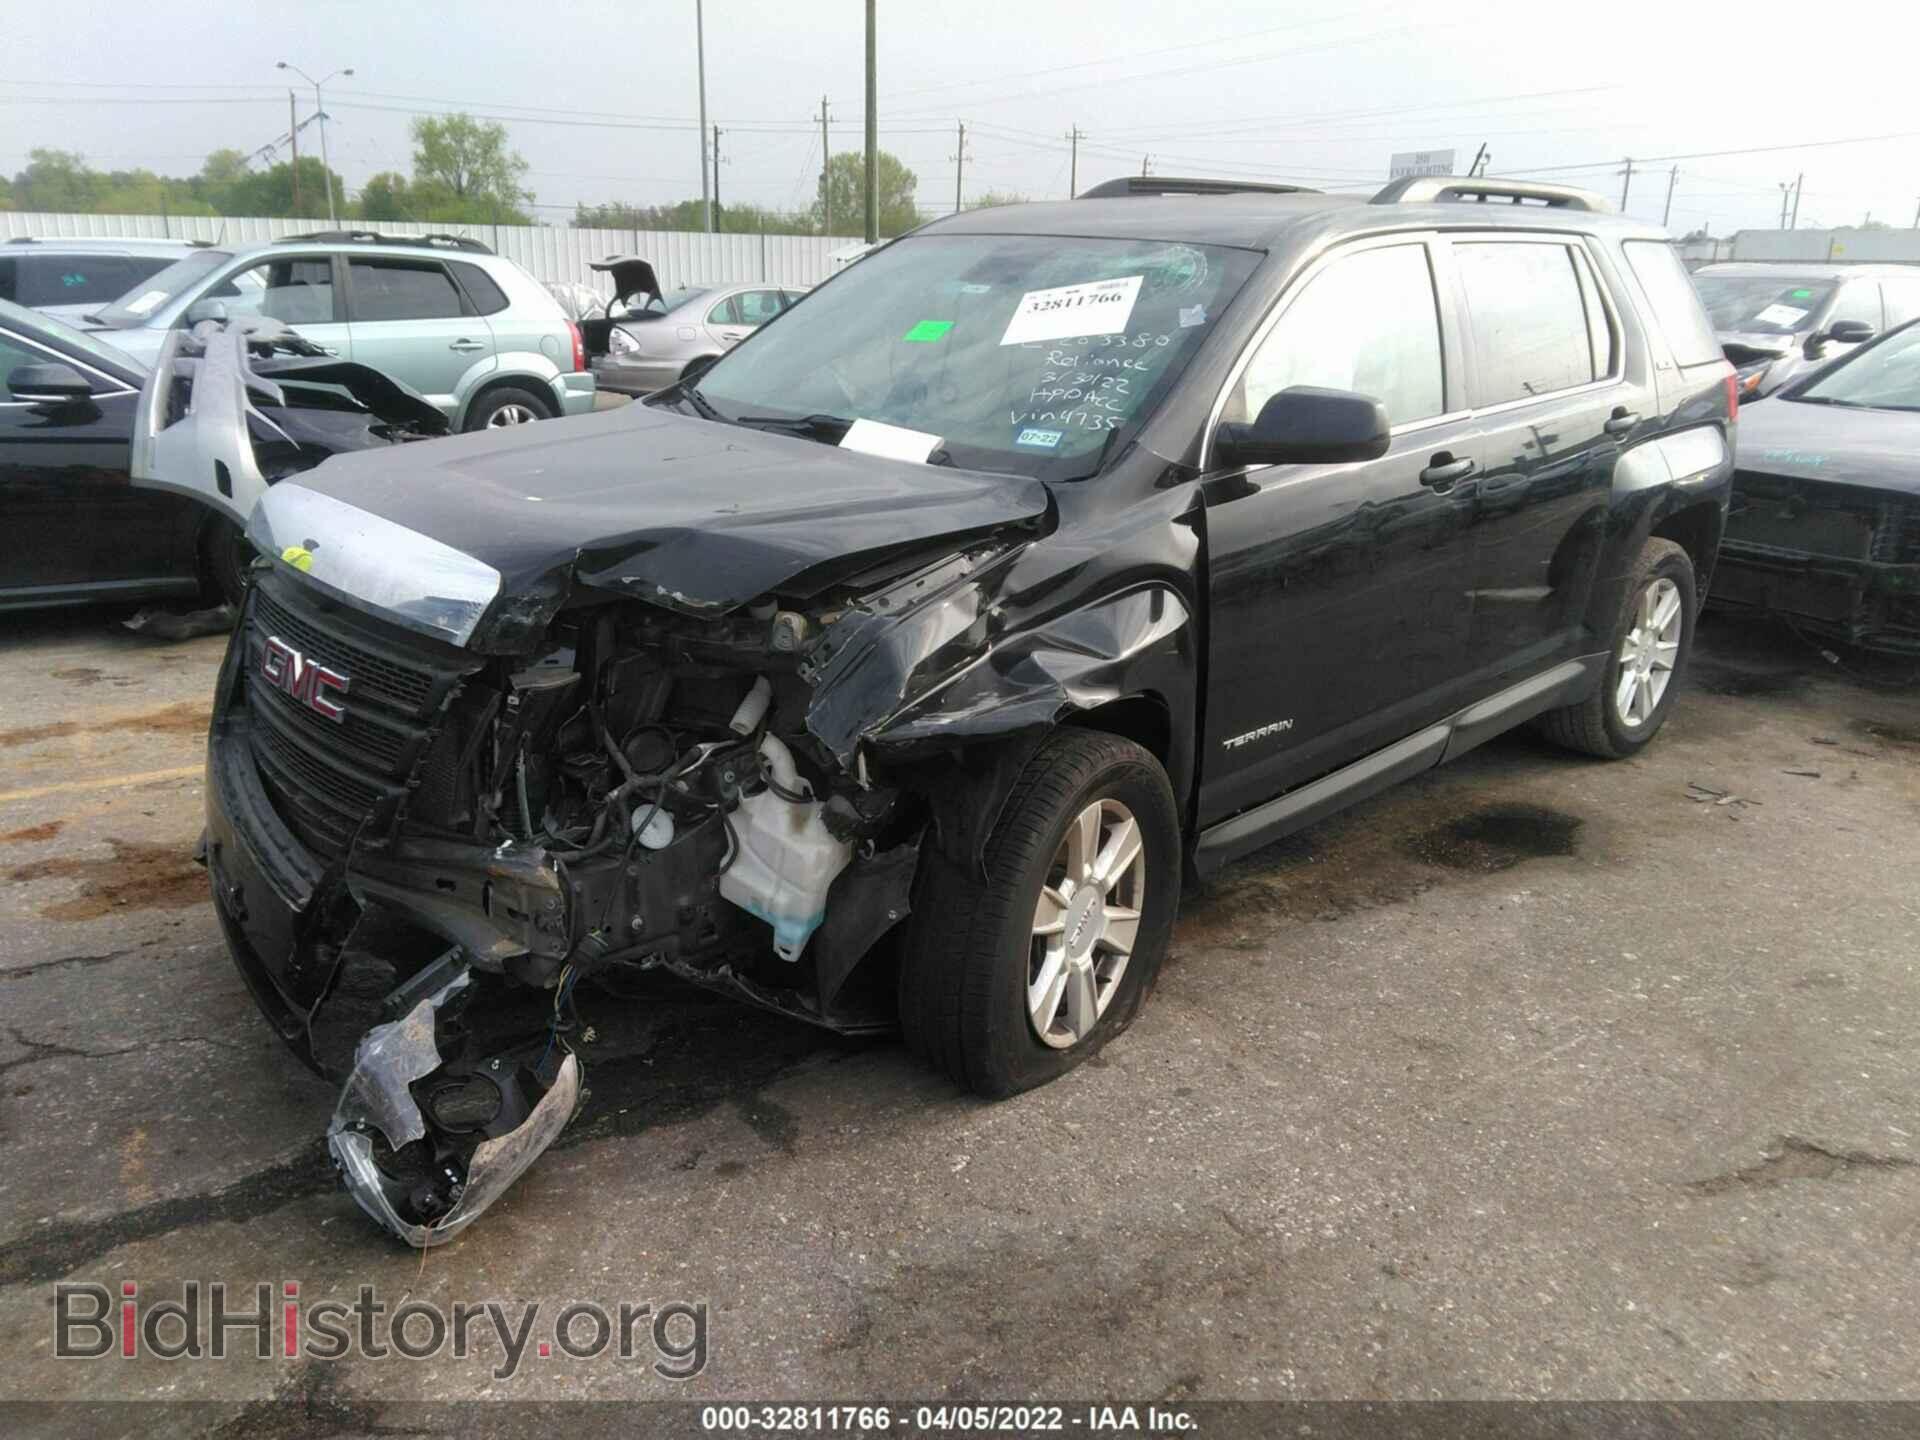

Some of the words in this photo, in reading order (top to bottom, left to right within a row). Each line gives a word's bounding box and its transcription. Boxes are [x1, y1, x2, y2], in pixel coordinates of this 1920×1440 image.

[1028, 293, 1122, 313] 32811766
[262, 636, 350, 724] GMC
[1223, 718, 1294, 750] TERRAIN
